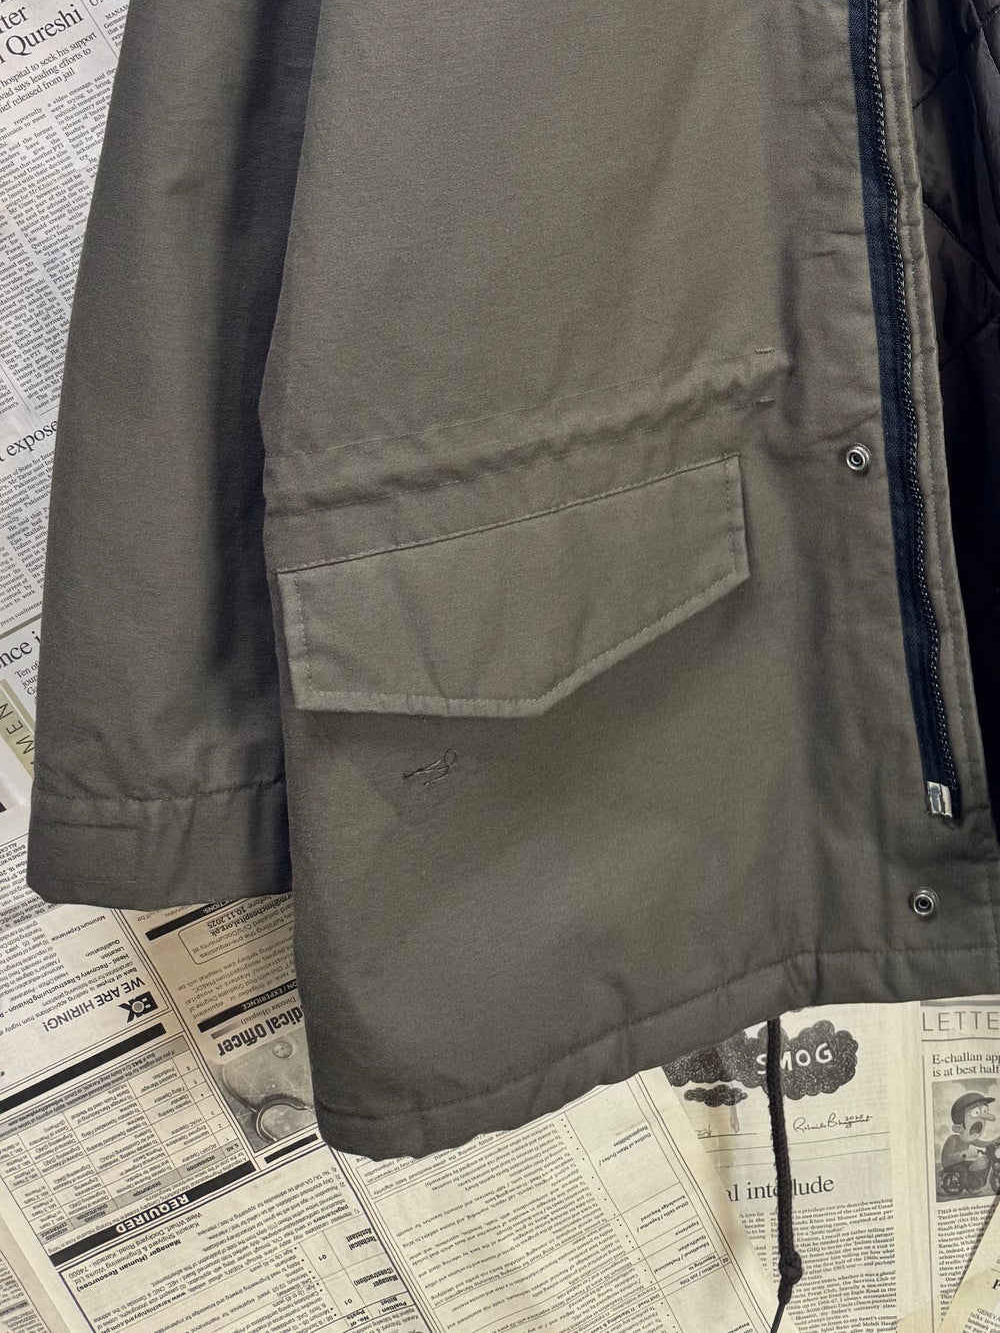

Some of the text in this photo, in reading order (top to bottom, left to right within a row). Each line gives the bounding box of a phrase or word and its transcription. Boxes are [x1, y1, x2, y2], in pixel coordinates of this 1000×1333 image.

[5, 3, 84, 55] Qureshi
[42, 976, 146, 1032] WE ARE HIRING!
[216, 1005, 304, 1057] dical Officer
[932, 1052, 983, 1065] E-challan
[932, 1066, 942, 1078] is
[943, 1067, 953, 1077] at
[955, 1065, 977, 1075] best
[747, 1175, 835, 1200] intlude
[115, 1194, 190, 1234] REQUIRED
[76, 1238, 182, 1293] Manager (Human Resources)
